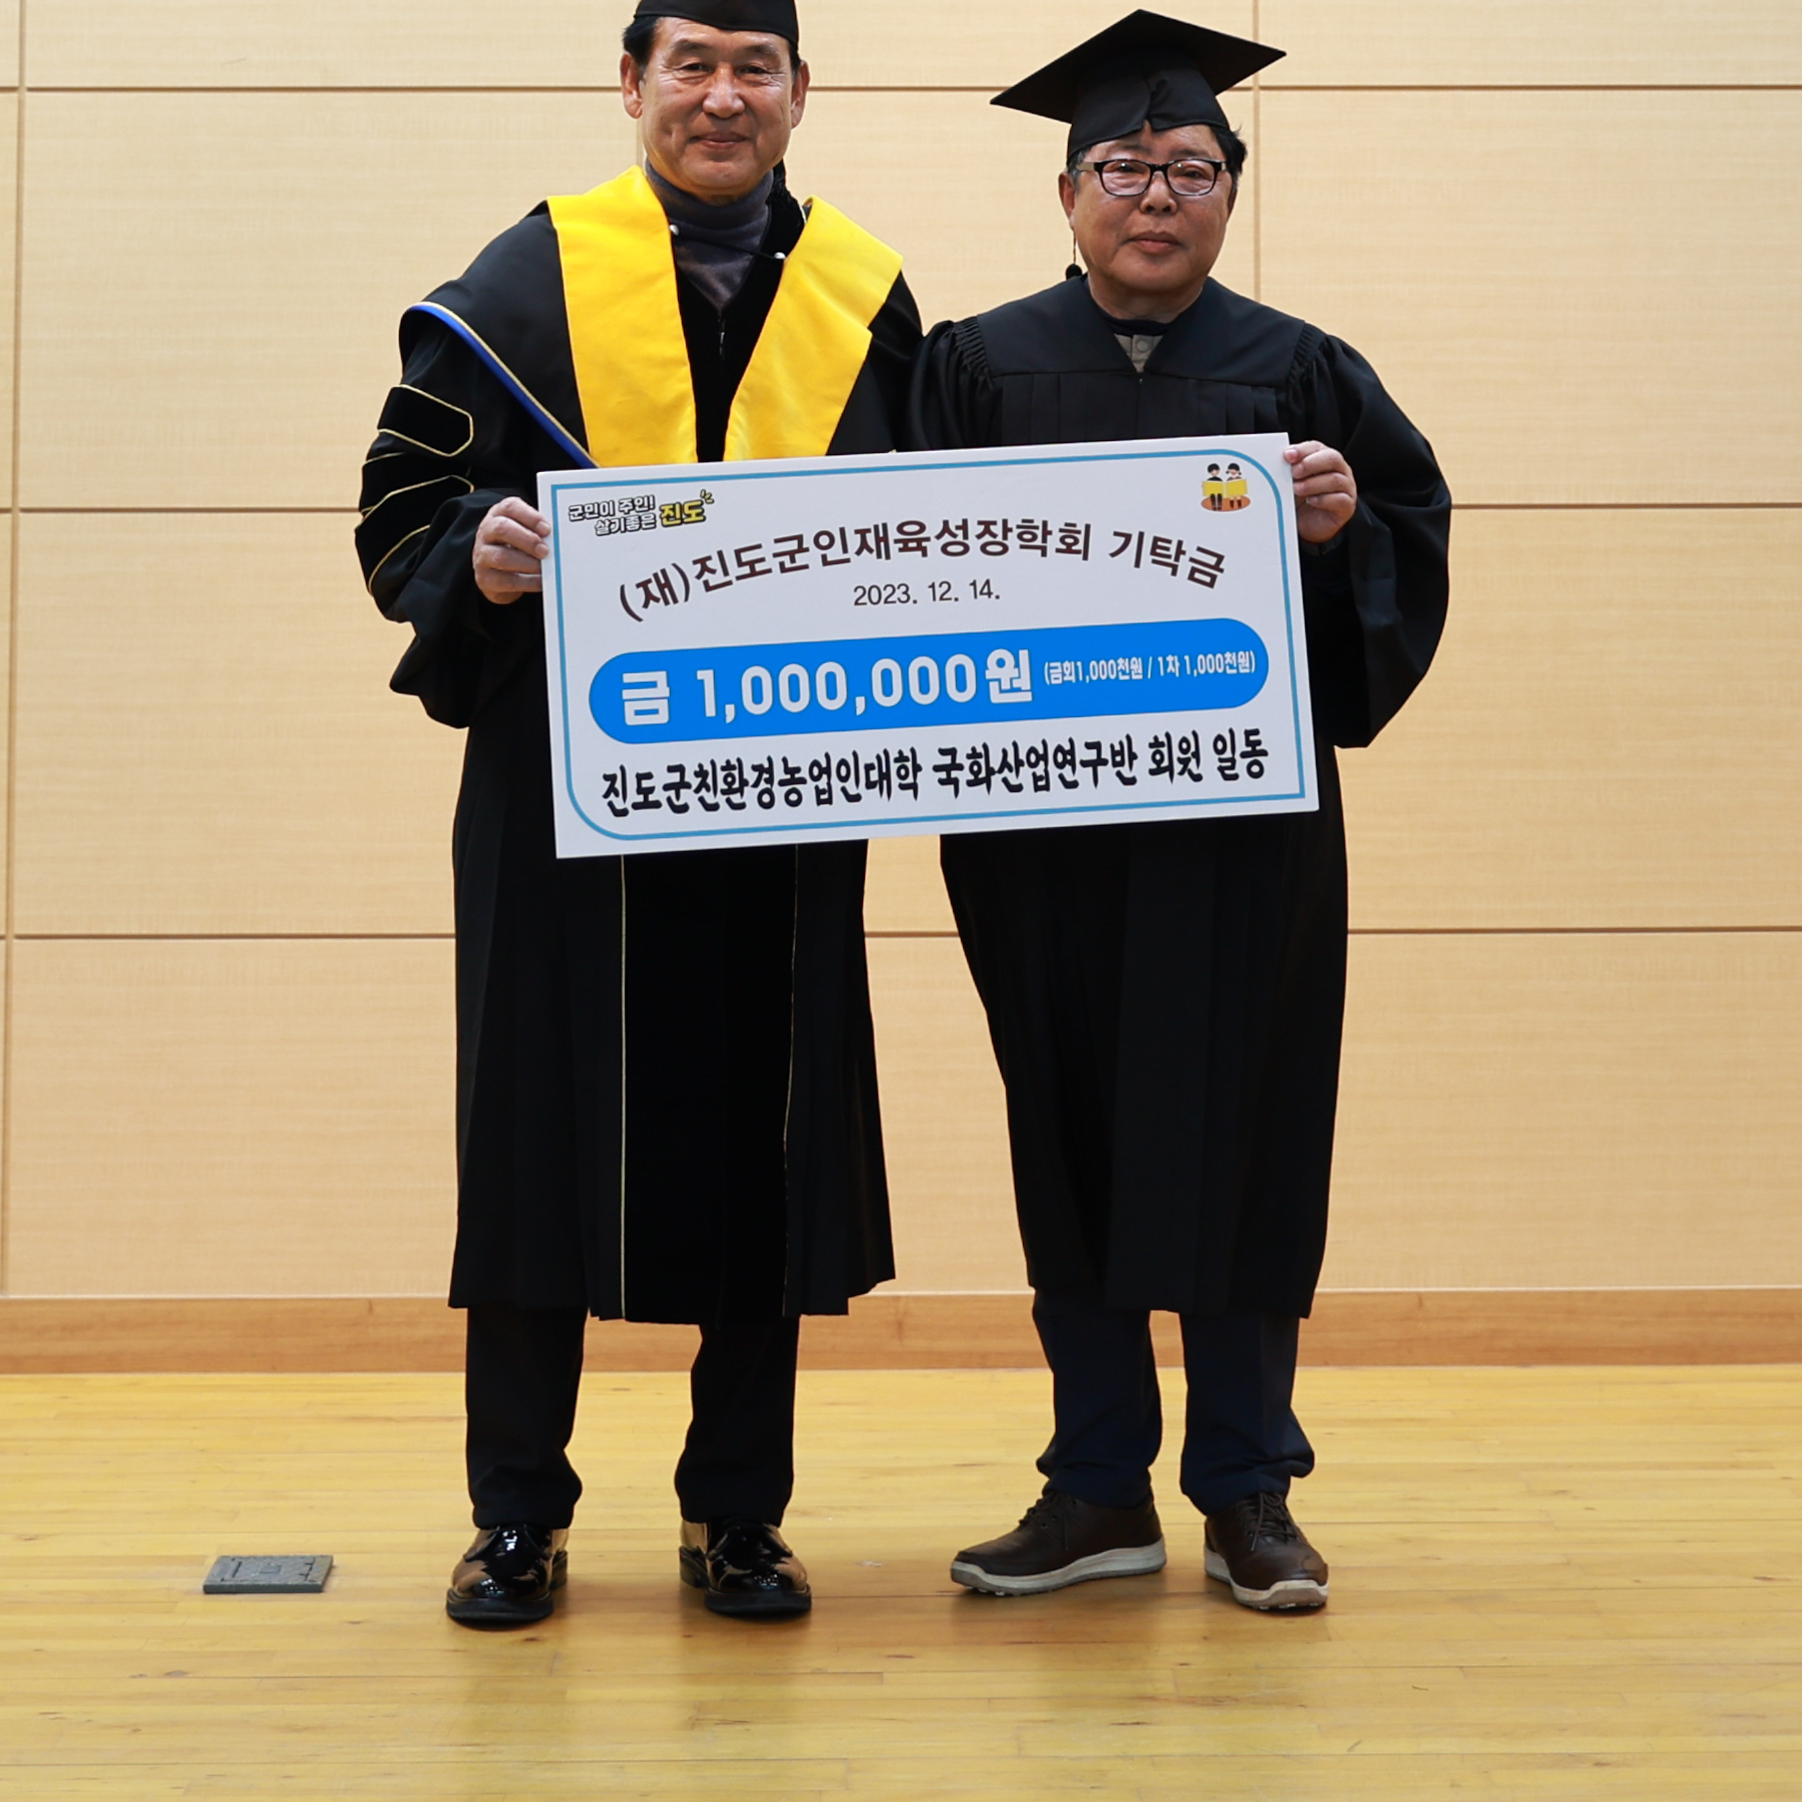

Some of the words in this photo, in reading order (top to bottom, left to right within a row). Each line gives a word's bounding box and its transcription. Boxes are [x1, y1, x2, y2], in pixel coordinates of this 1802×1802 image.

[568, 500, 615, 521] 군민이
[618, 494, 656, 515] 주인!
[659, 500, 706, 527] 진도
[619, 519, 1091, 622] (재)진도군인재육성장학회
[1109, 531, 1226, 589] 기탁금
[853, 583, 918, 606] 2023.
[928, 580, 960, 602] 12.
[969, 579, 1001, 599] 14.
[1157, 655, 1181, 677] 1차
[622, 671, 670, 725] 금
[696, 649, 1032, 724] 1,000,000원
[601, 746, 923, 818] 진도군친환경농업인대학
[932, 734, 1139, 799] 국화산업연구반
[1148, 730, 1203, 784] 회원
[1212, 727, 1269, 781] 일동
